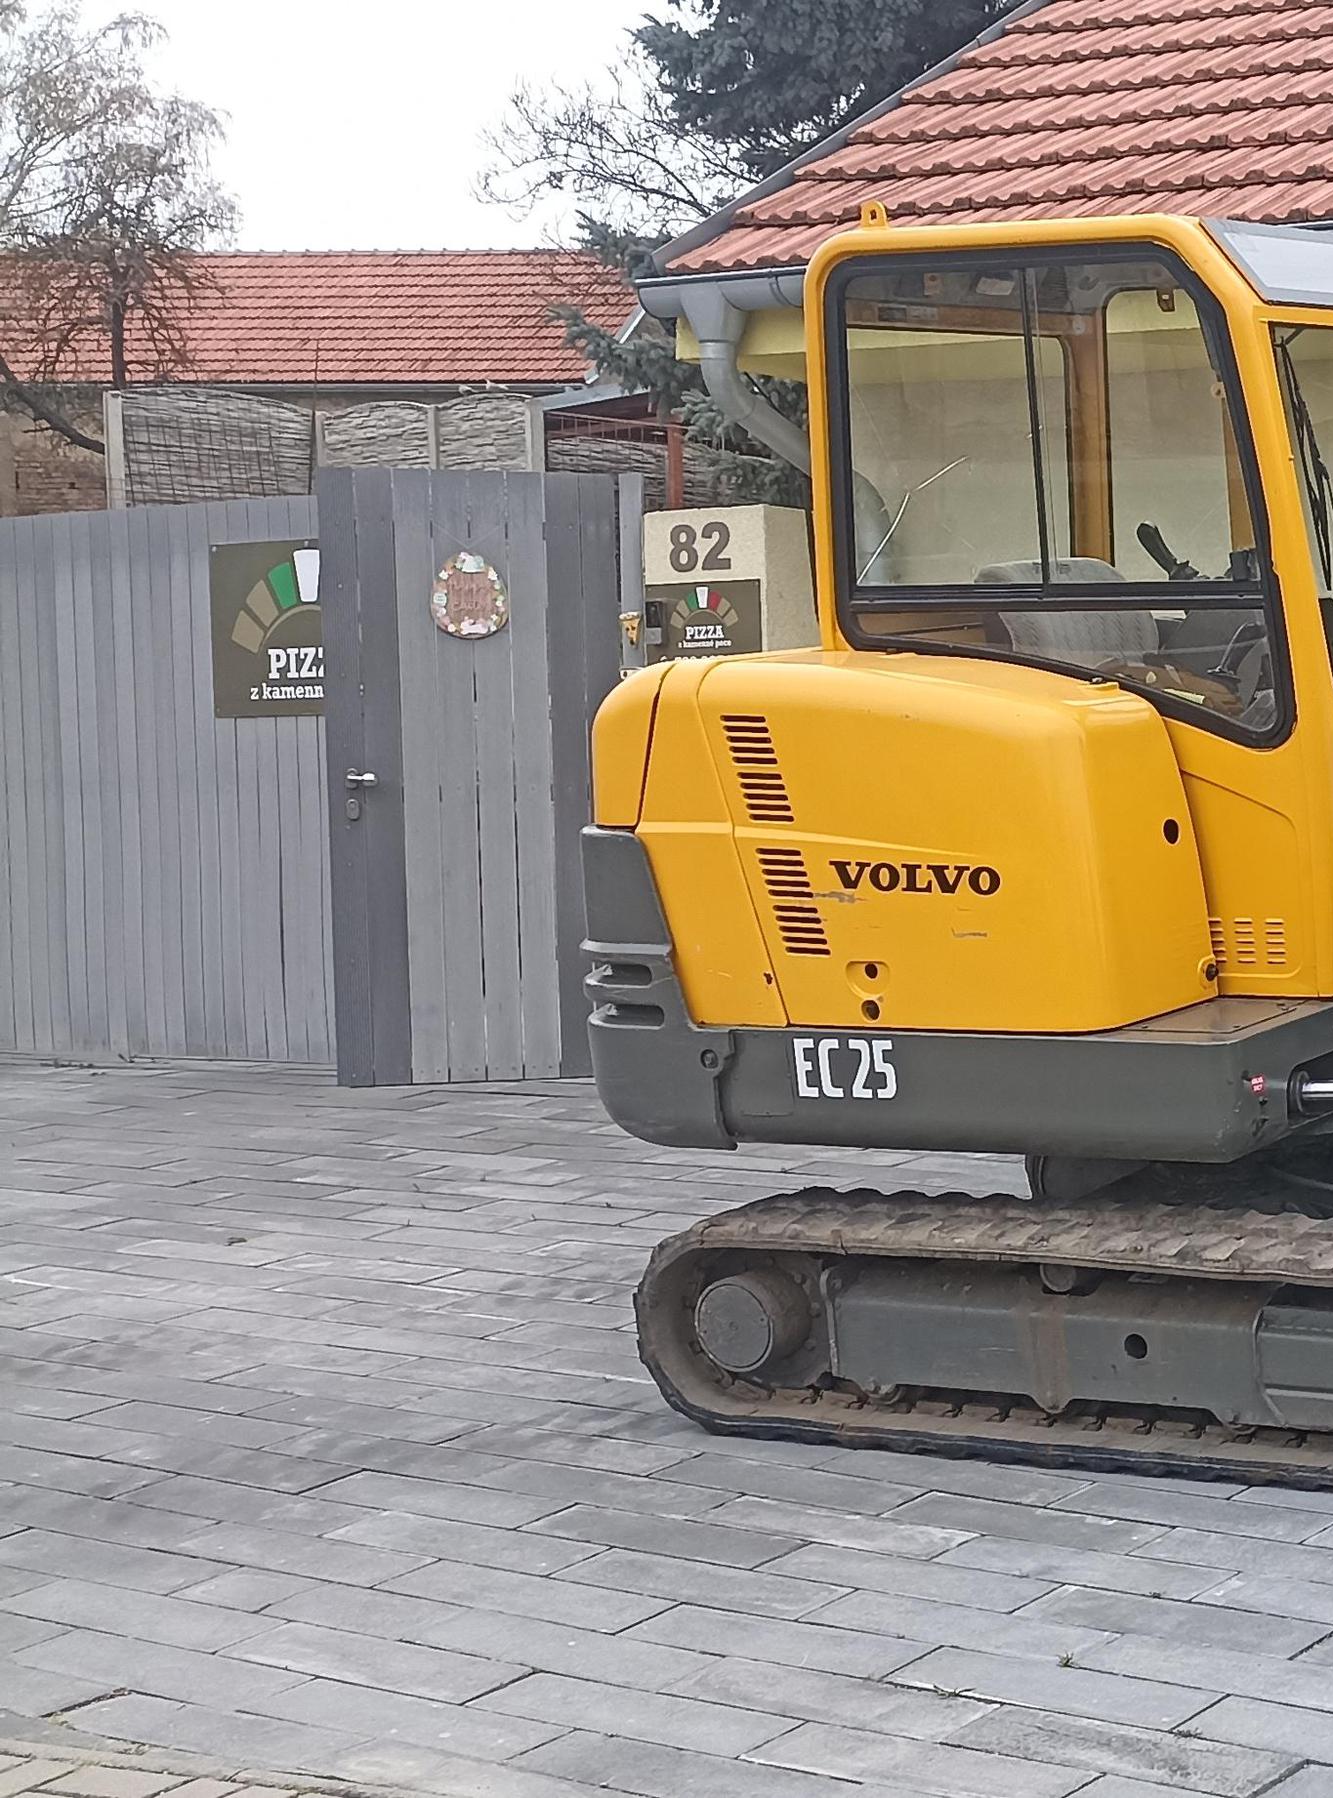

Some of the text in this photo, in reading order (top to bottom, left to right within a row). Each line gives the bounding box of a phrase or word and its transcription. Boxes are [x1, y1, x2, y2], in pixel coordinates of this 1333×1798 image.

[669, 521, 732, 573] 82
[685, 625, 725, 640] PIZZA
[250, 687, 259, 700] z
[828, 860, 1001, 896] VOLVO
